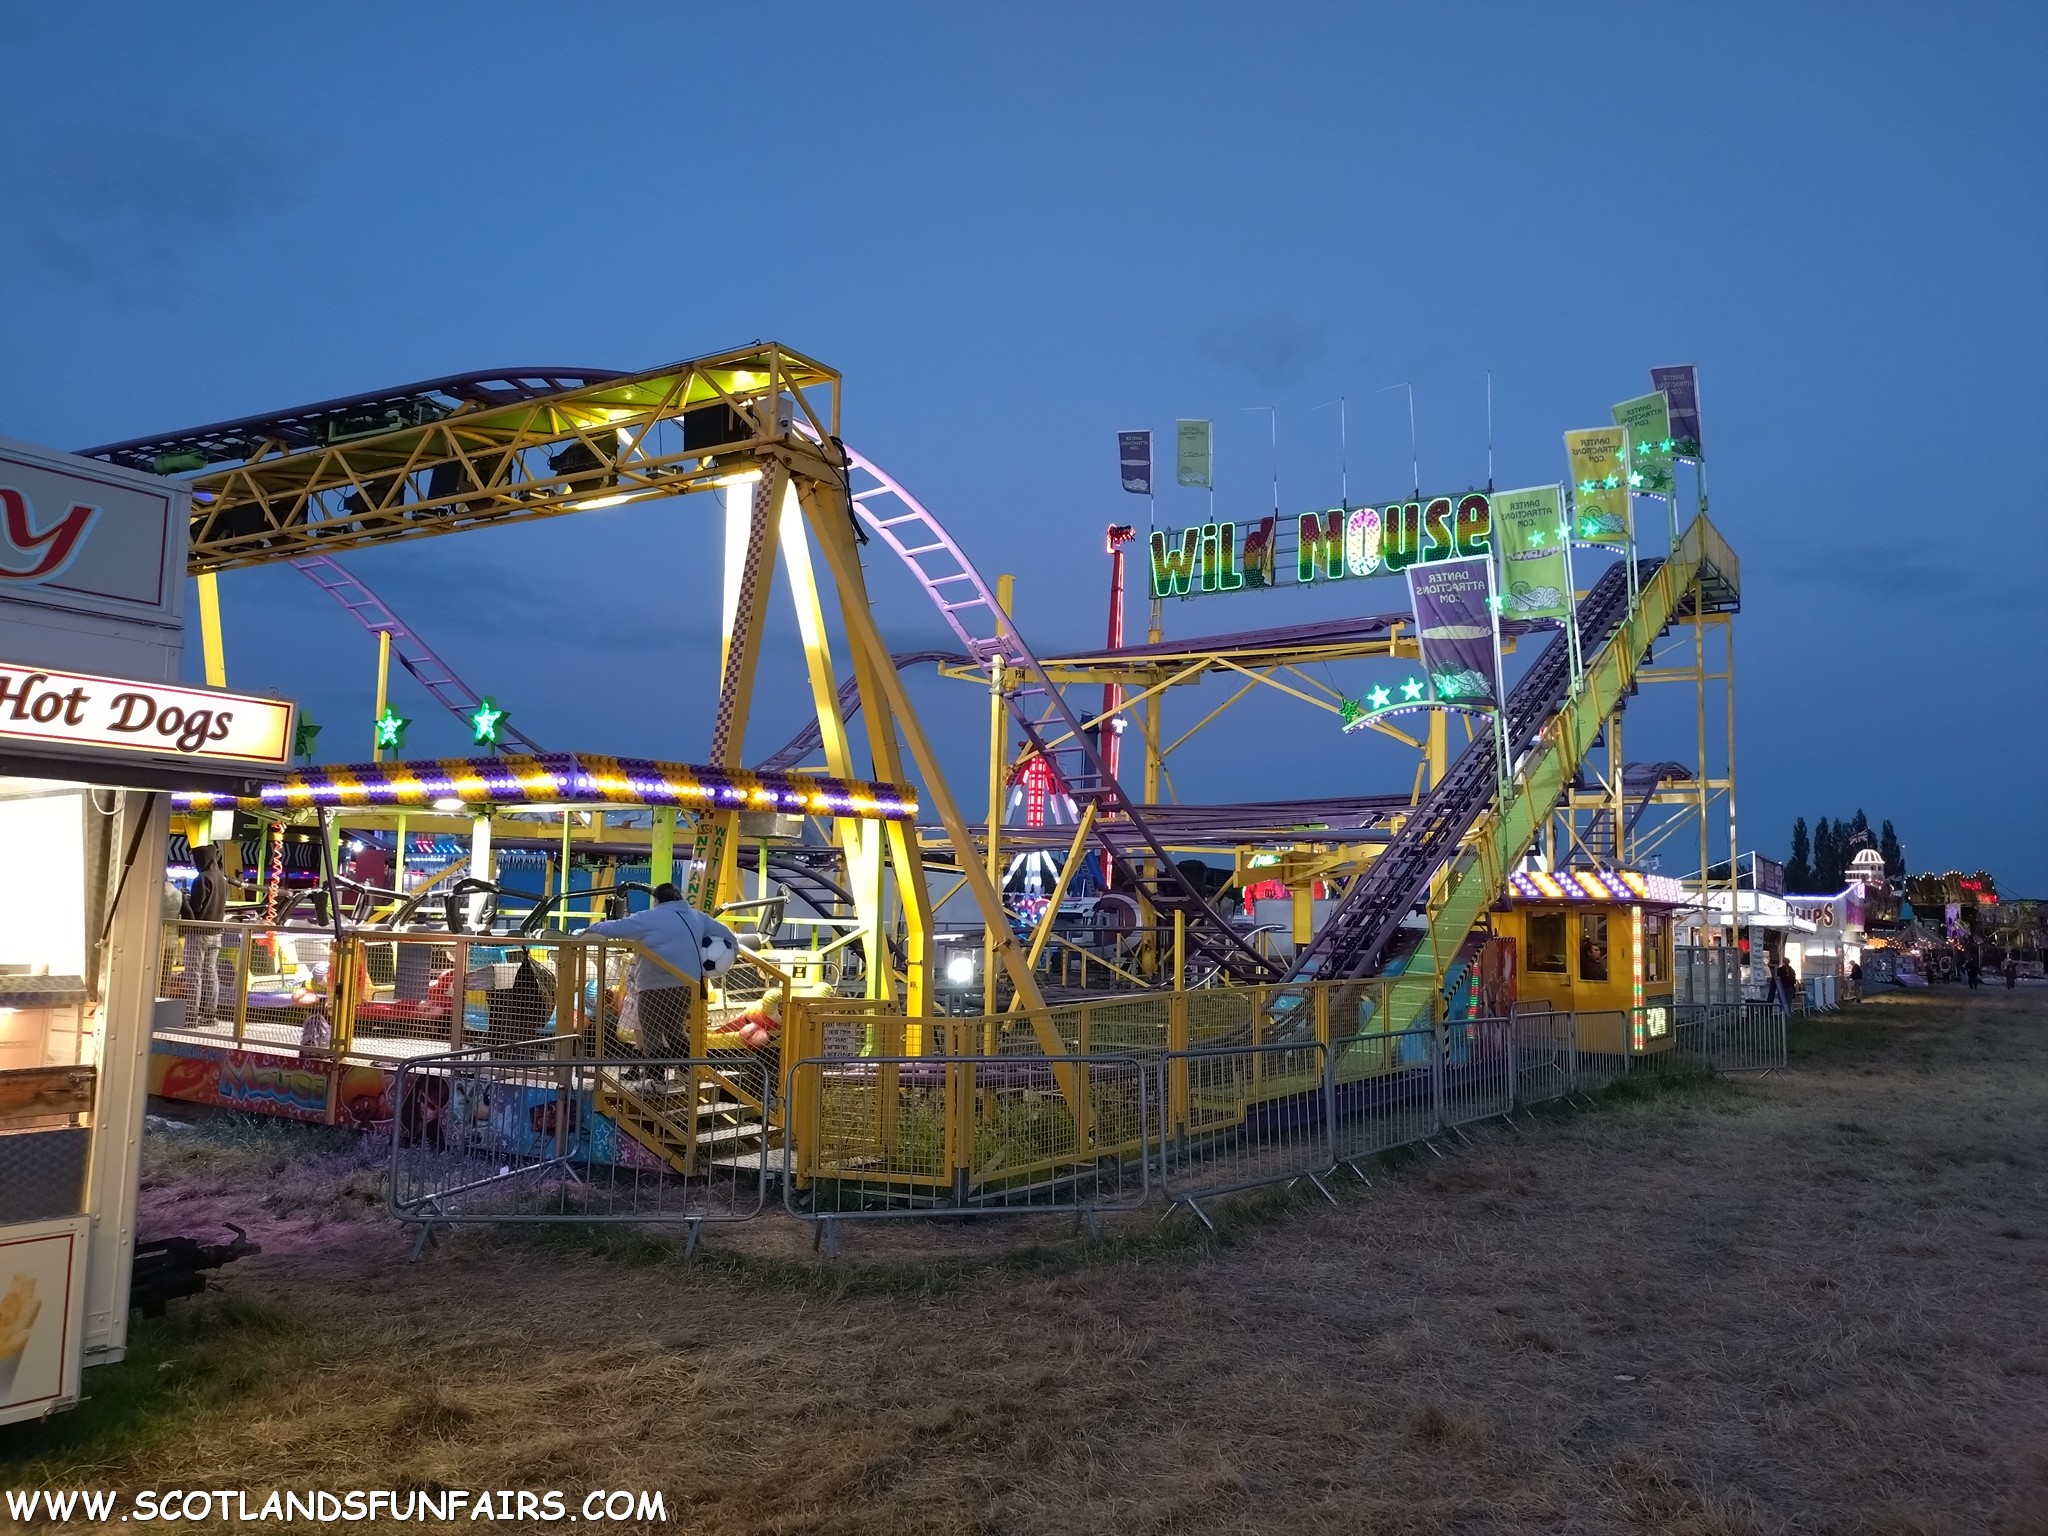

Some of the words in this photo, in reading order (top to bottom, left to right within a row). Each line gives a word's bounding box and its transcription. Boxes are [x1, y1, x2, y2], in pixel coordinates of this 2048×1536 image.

[0, 672, 91, 727] Hot
[106, 692, 234, 753] Dogs
[686, 824, 711, 909] ENTANC
[711, 825, 727, 868] WAIT
[703, 878, 718, 914] HER
